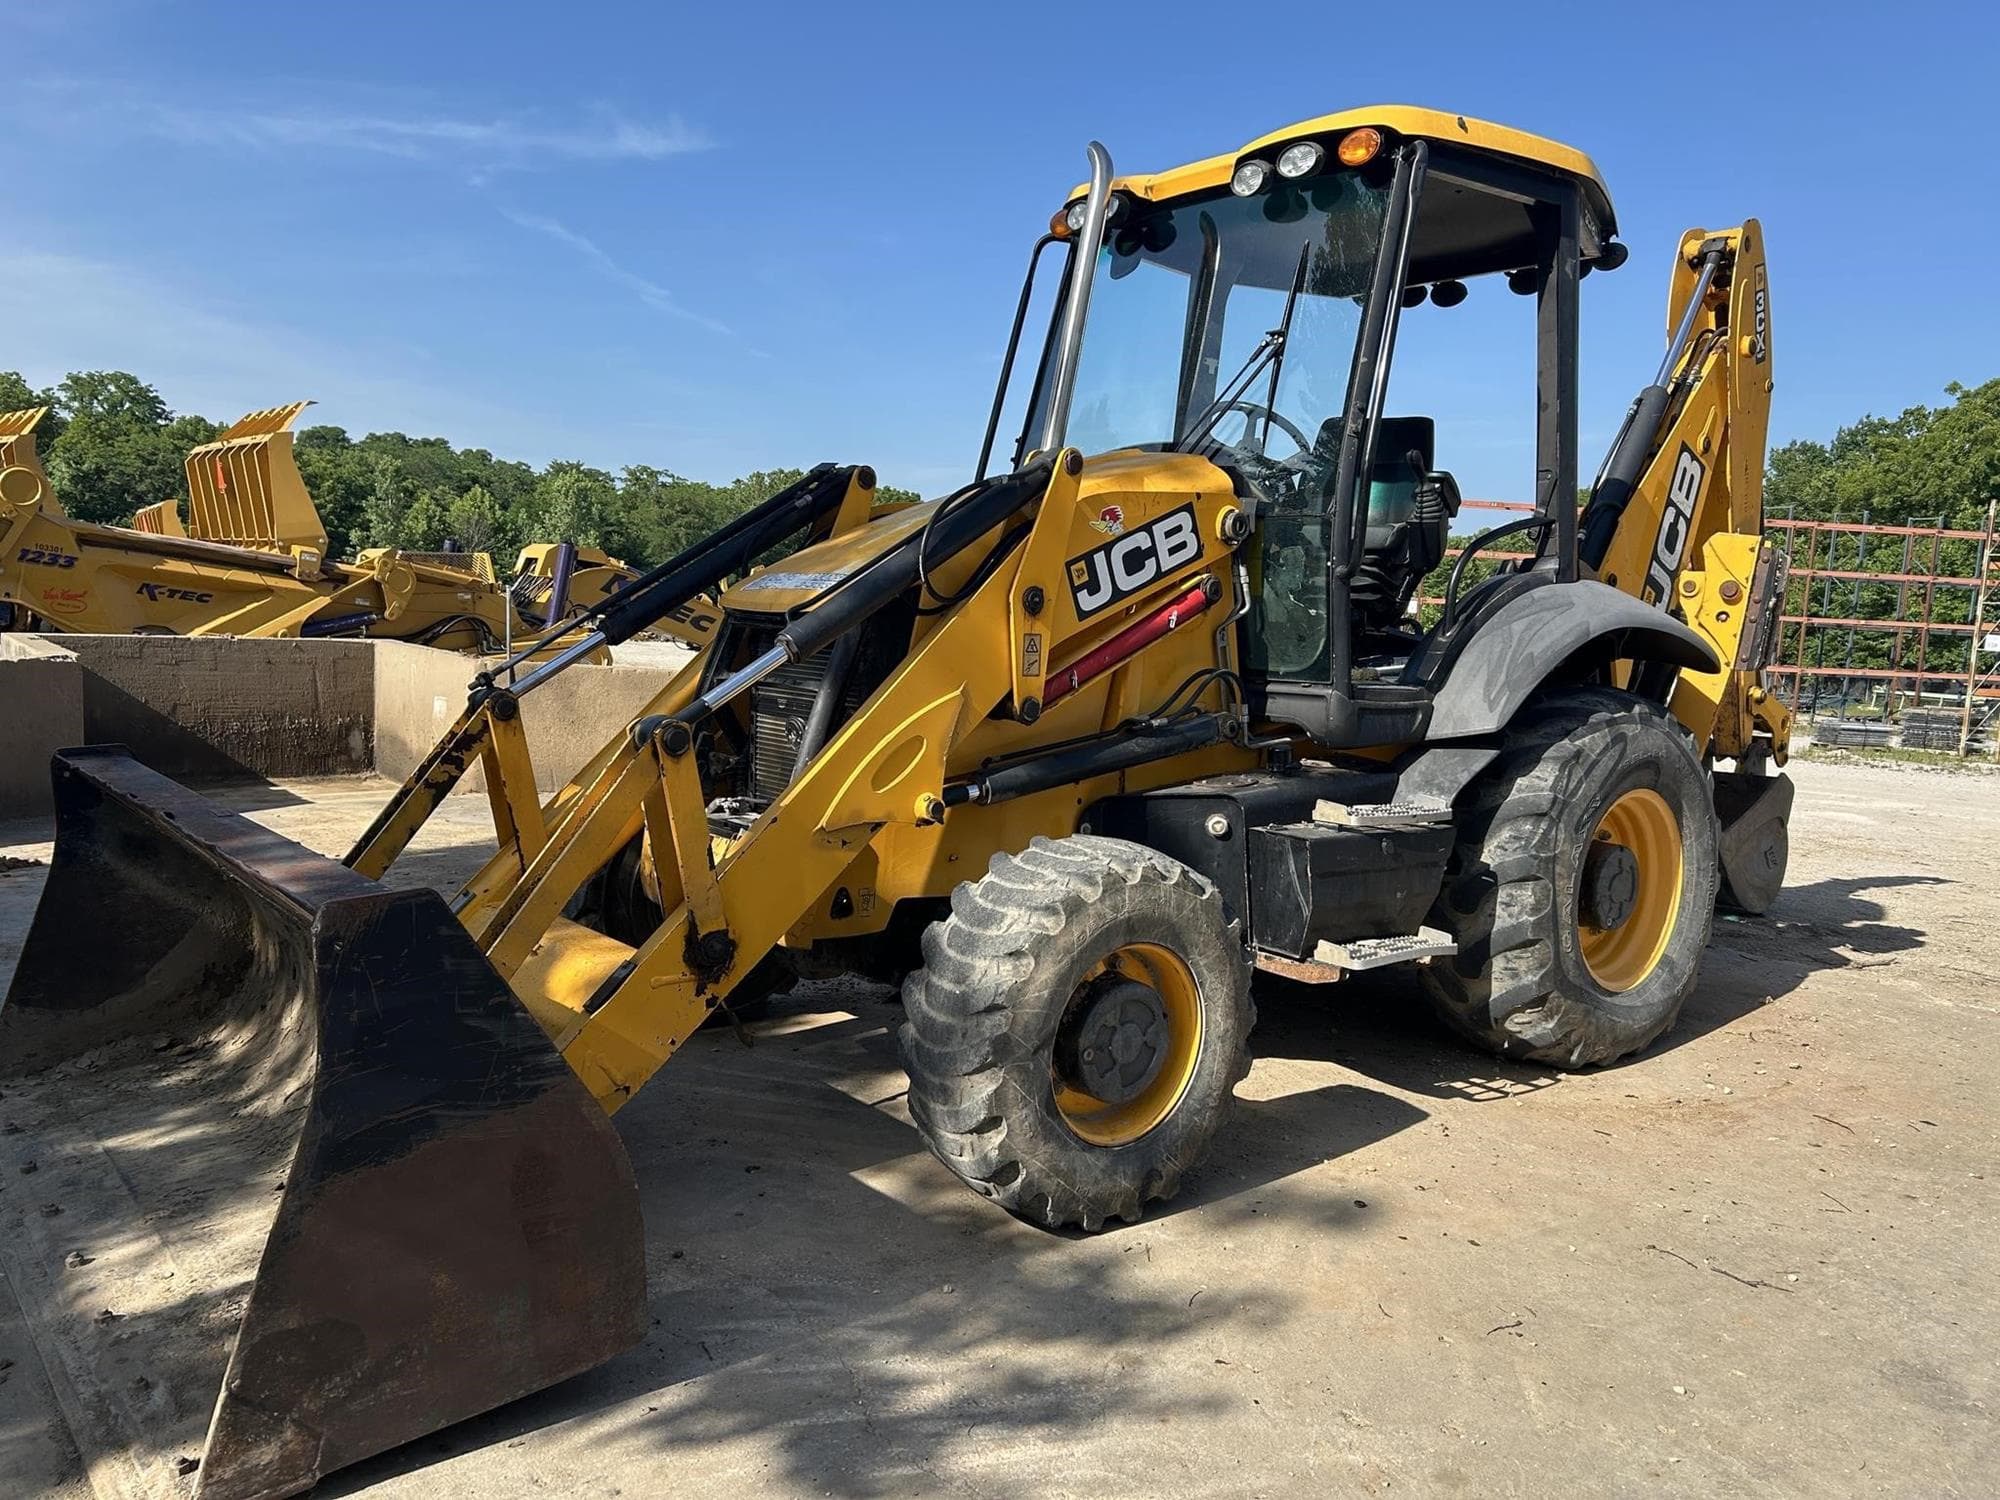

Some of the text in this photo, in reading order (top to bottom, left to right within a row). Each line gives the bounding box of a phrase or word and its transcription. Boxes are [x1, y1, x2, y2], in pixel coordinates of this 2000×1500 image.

[17, 548, 78, 568] 1233
[1077, 511, 1198, 611] JCB
[1650, 451, 1701, 613] JCB
[136, 582, 214, 603] K-TEC
